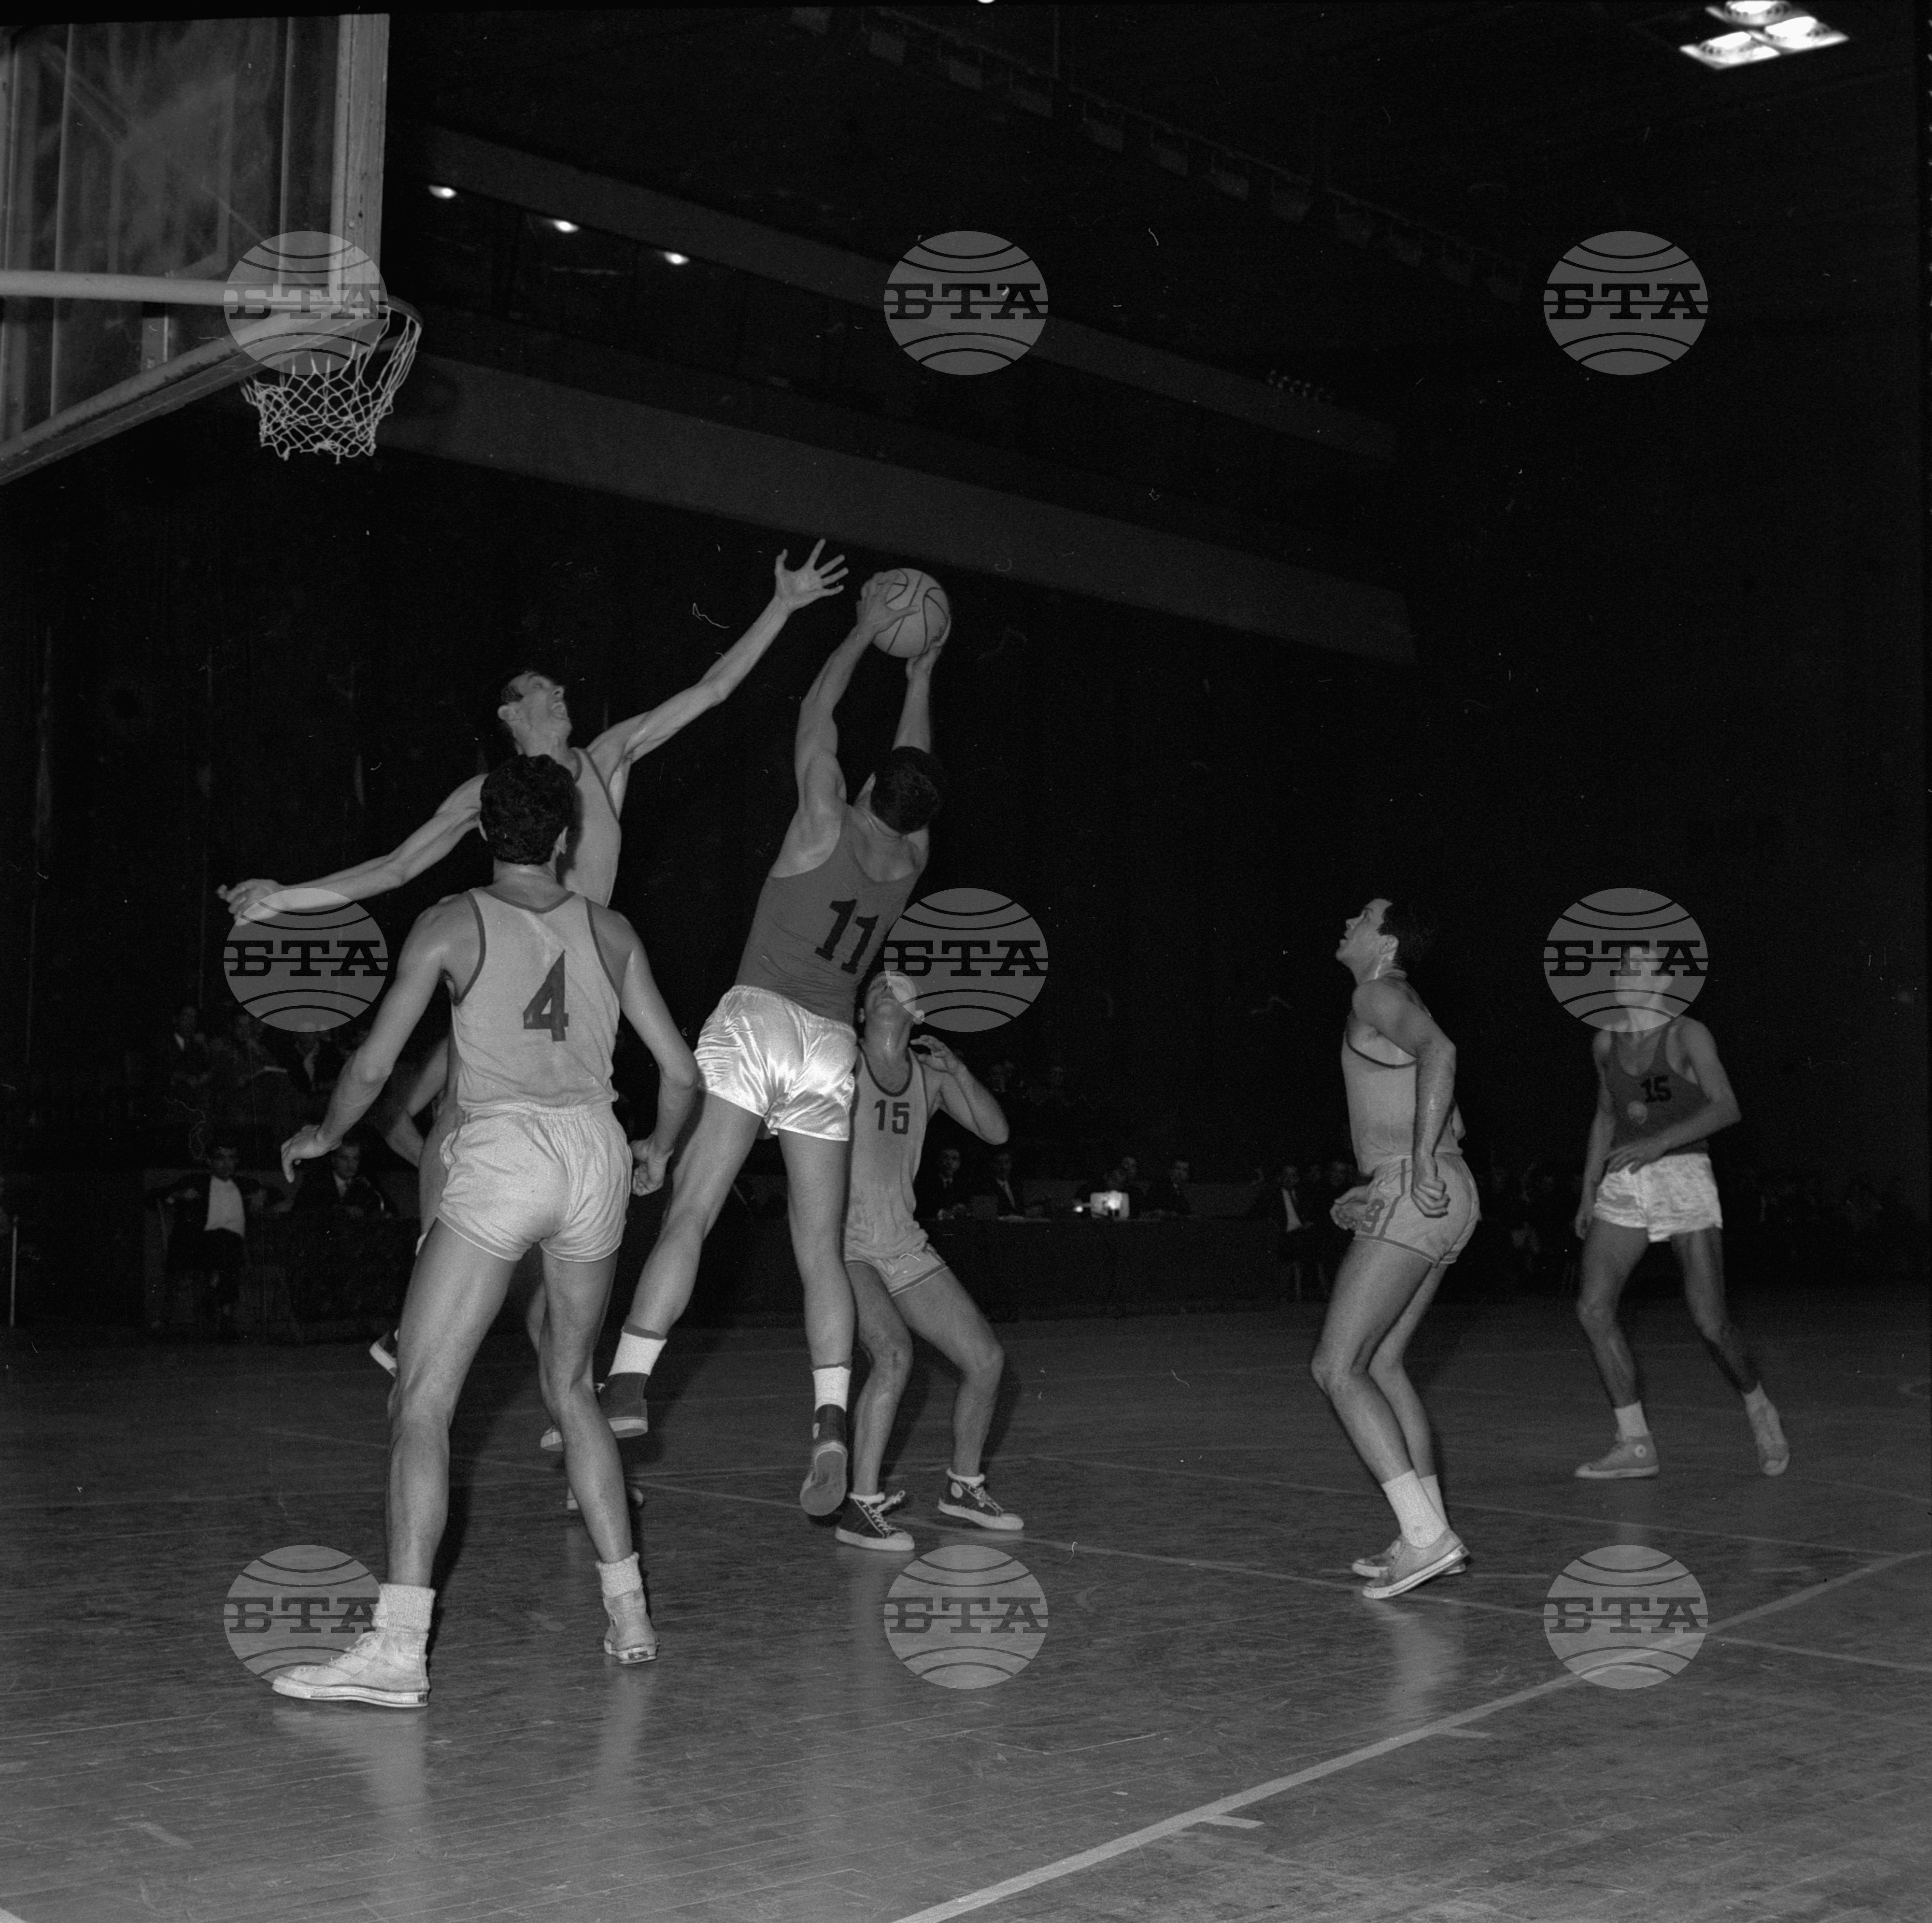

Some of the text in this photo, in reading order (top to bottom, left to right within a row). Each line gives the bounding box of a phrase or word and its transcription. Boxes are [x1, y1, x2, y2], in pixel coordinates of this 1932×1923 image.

[815, 899, 879, 974] 11
[523, 950, 568, 1041] 4
[874, 1099, 909, 1135] 15
[1641, 1076, 1672, 1103] 15
